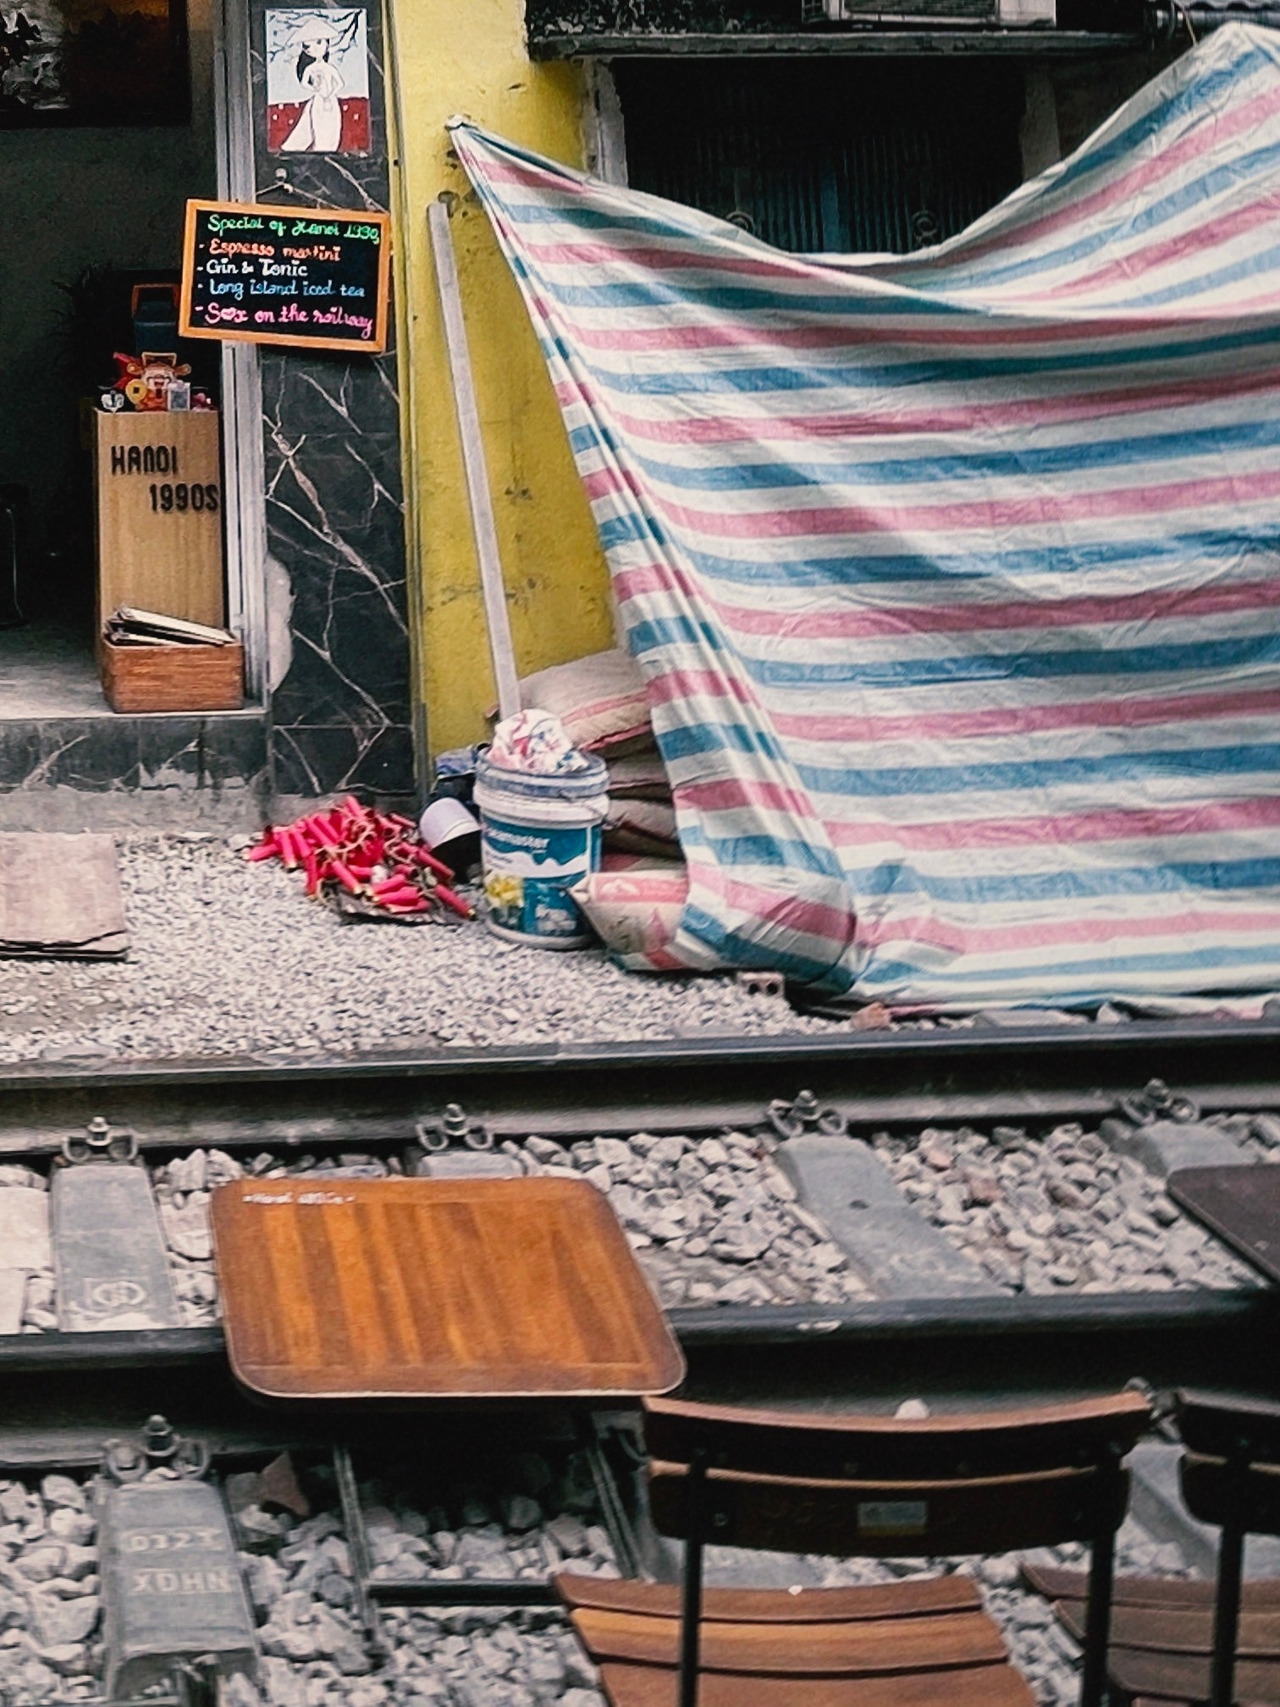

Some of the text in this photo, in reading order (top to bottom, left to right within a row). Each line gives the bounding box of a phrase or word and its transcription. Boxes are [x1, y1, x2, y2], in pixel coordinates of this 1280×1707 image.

[208, 214, 265, 237] Special
[209, 238, 275, 259] Espresso
[206, 258, 239, 275] Gin
[259, 258, 309, 277] Tonic
[339, 284, 366, 297] tea
[254, 310, 276, 323] on
[278, 303, 310, 323] the
